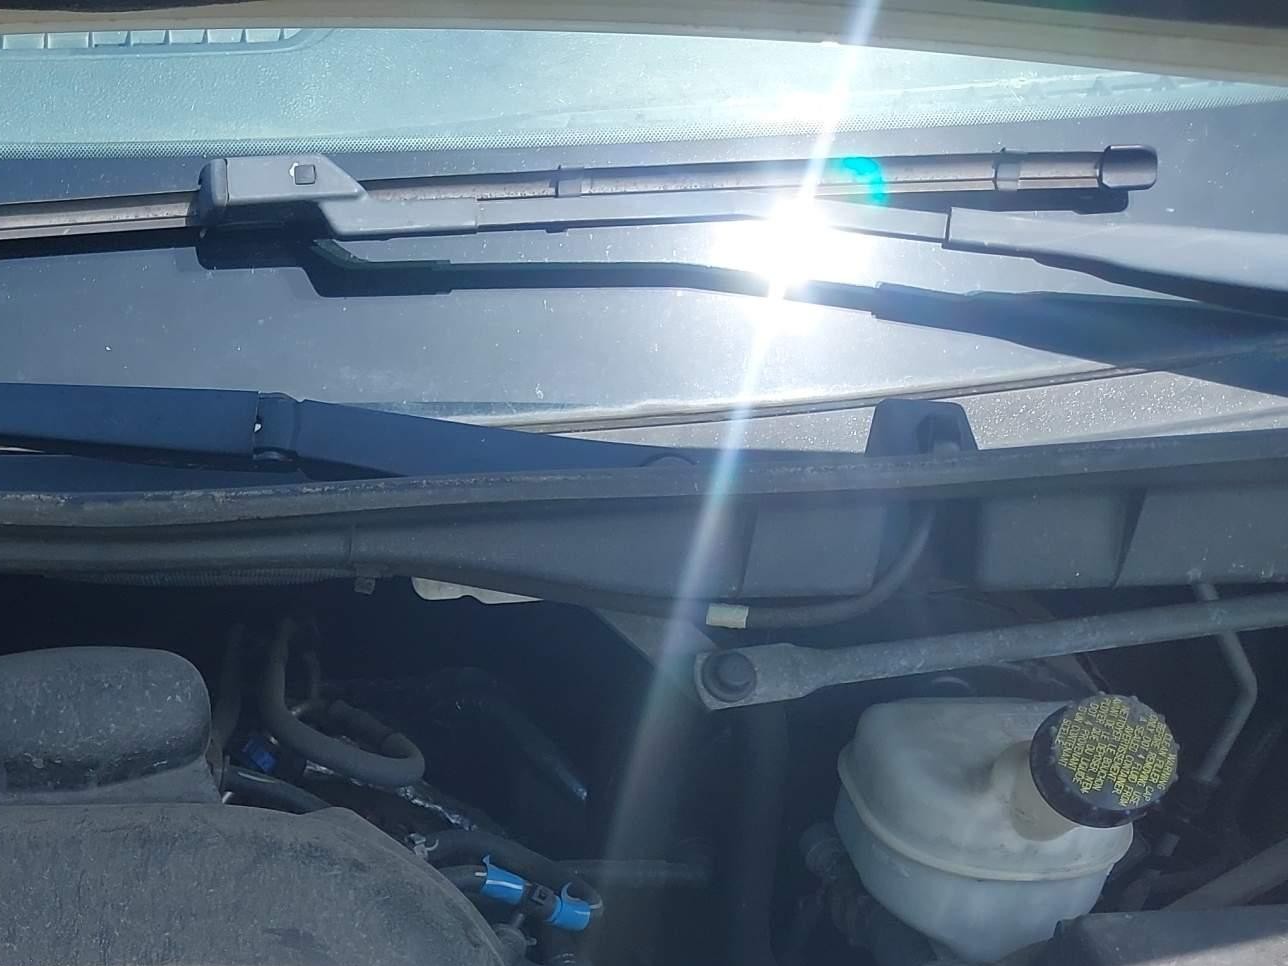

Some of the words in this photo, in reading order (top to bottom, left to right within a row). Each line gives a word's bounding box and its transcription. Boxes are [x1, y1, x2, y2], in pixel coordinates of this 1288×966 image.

[1085, 744, 1096, 755] DU
[1106, 743, 1117, 753] LE
[1141, 736, 1151, 751] DOT
[1159, 733, 1172, 755] CLEAN
[1092, 757, 1111, 791] BOUCHON
[1112, 755, 1134, 794] CONTAINER
[1128, 762, 1142, 783] FLUID
[1148, 758, 1165, 783] FILLER
[1157, 753, 1176, 790] WARNING
[1119, 785, 1134, 807] FROM
[1143, 786, 1153, 801] CAP
